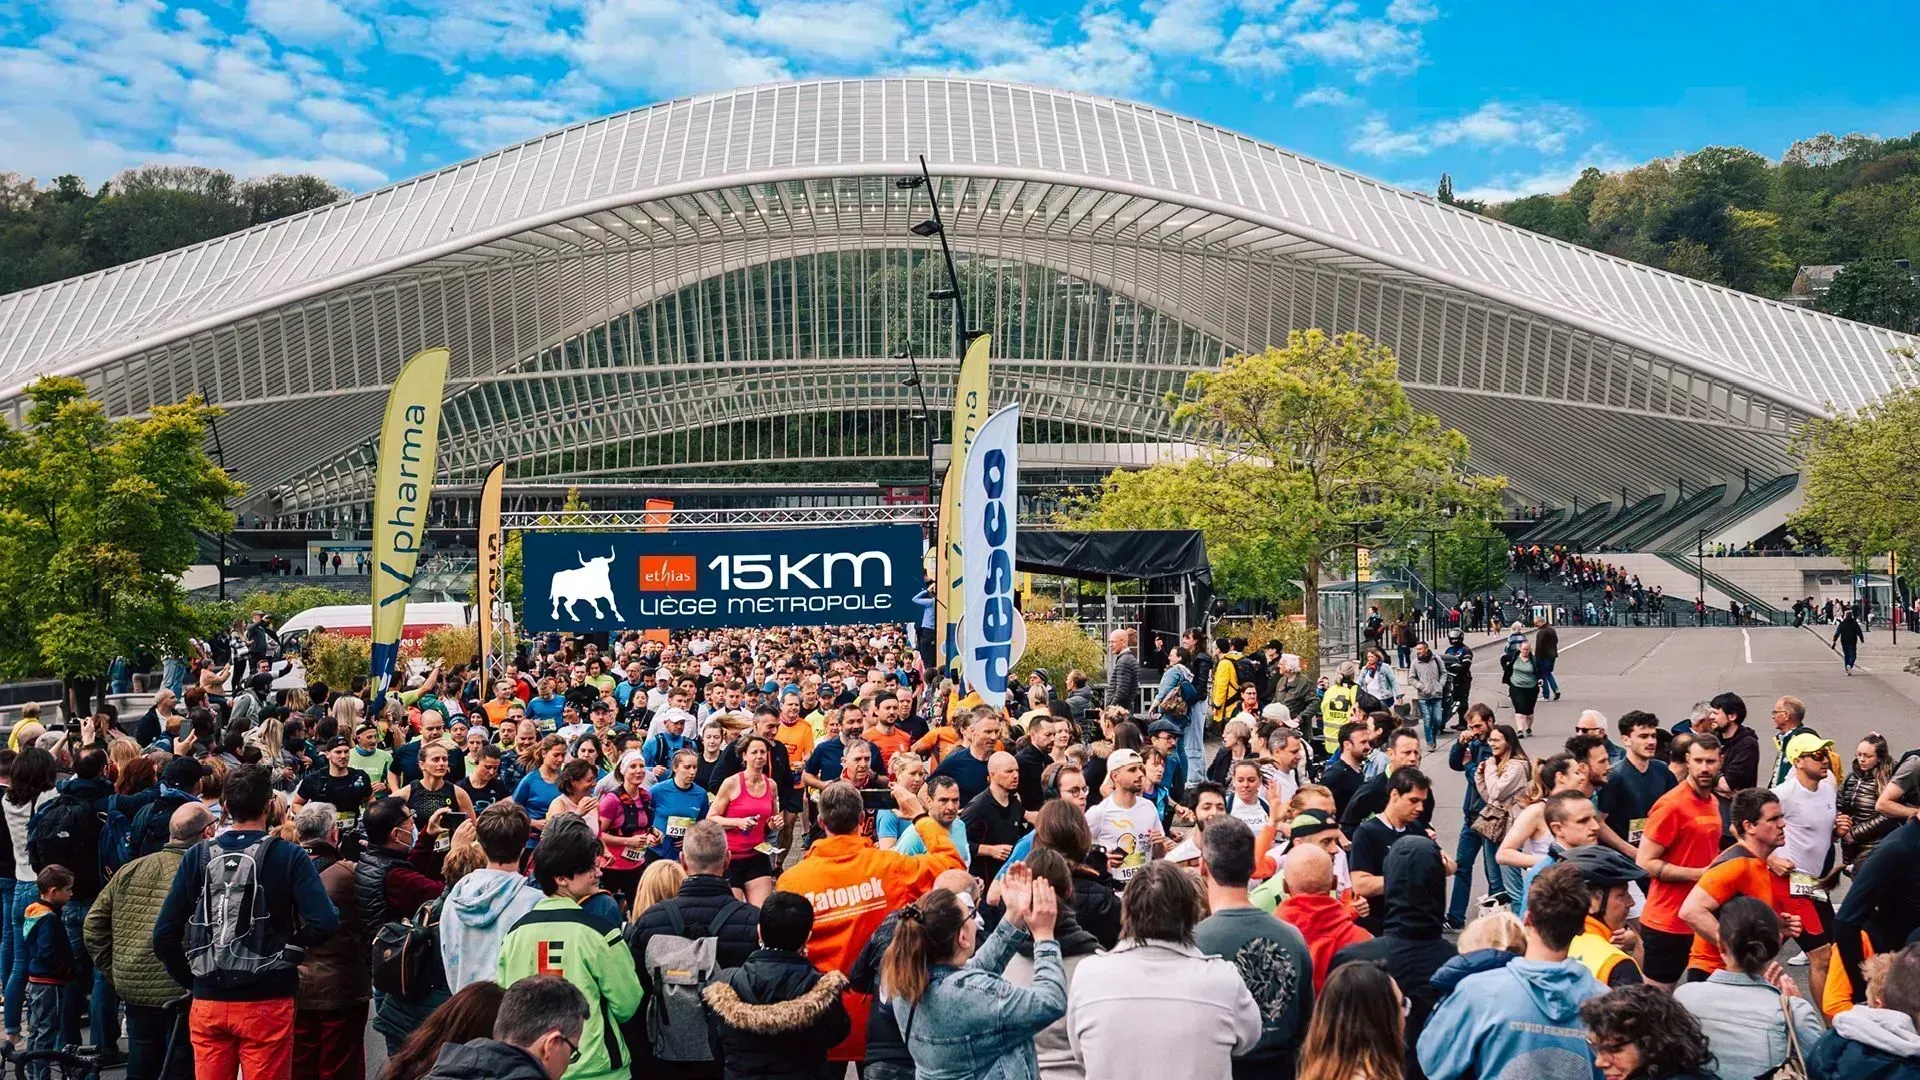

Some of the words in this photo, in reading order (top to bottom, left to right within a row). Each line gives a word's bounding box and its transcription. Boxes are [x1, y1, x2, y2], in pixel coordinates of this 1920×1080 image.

[388, 404, 425, 553] pharma
[645, 558, 691, 587] ethias
[975, 449, 1014, 693] desco
[728, 593, 892, 613] METROPOLE
[1329, 711, 1348, 719] MEDIA
[669, 826, 687, 835] 2518
